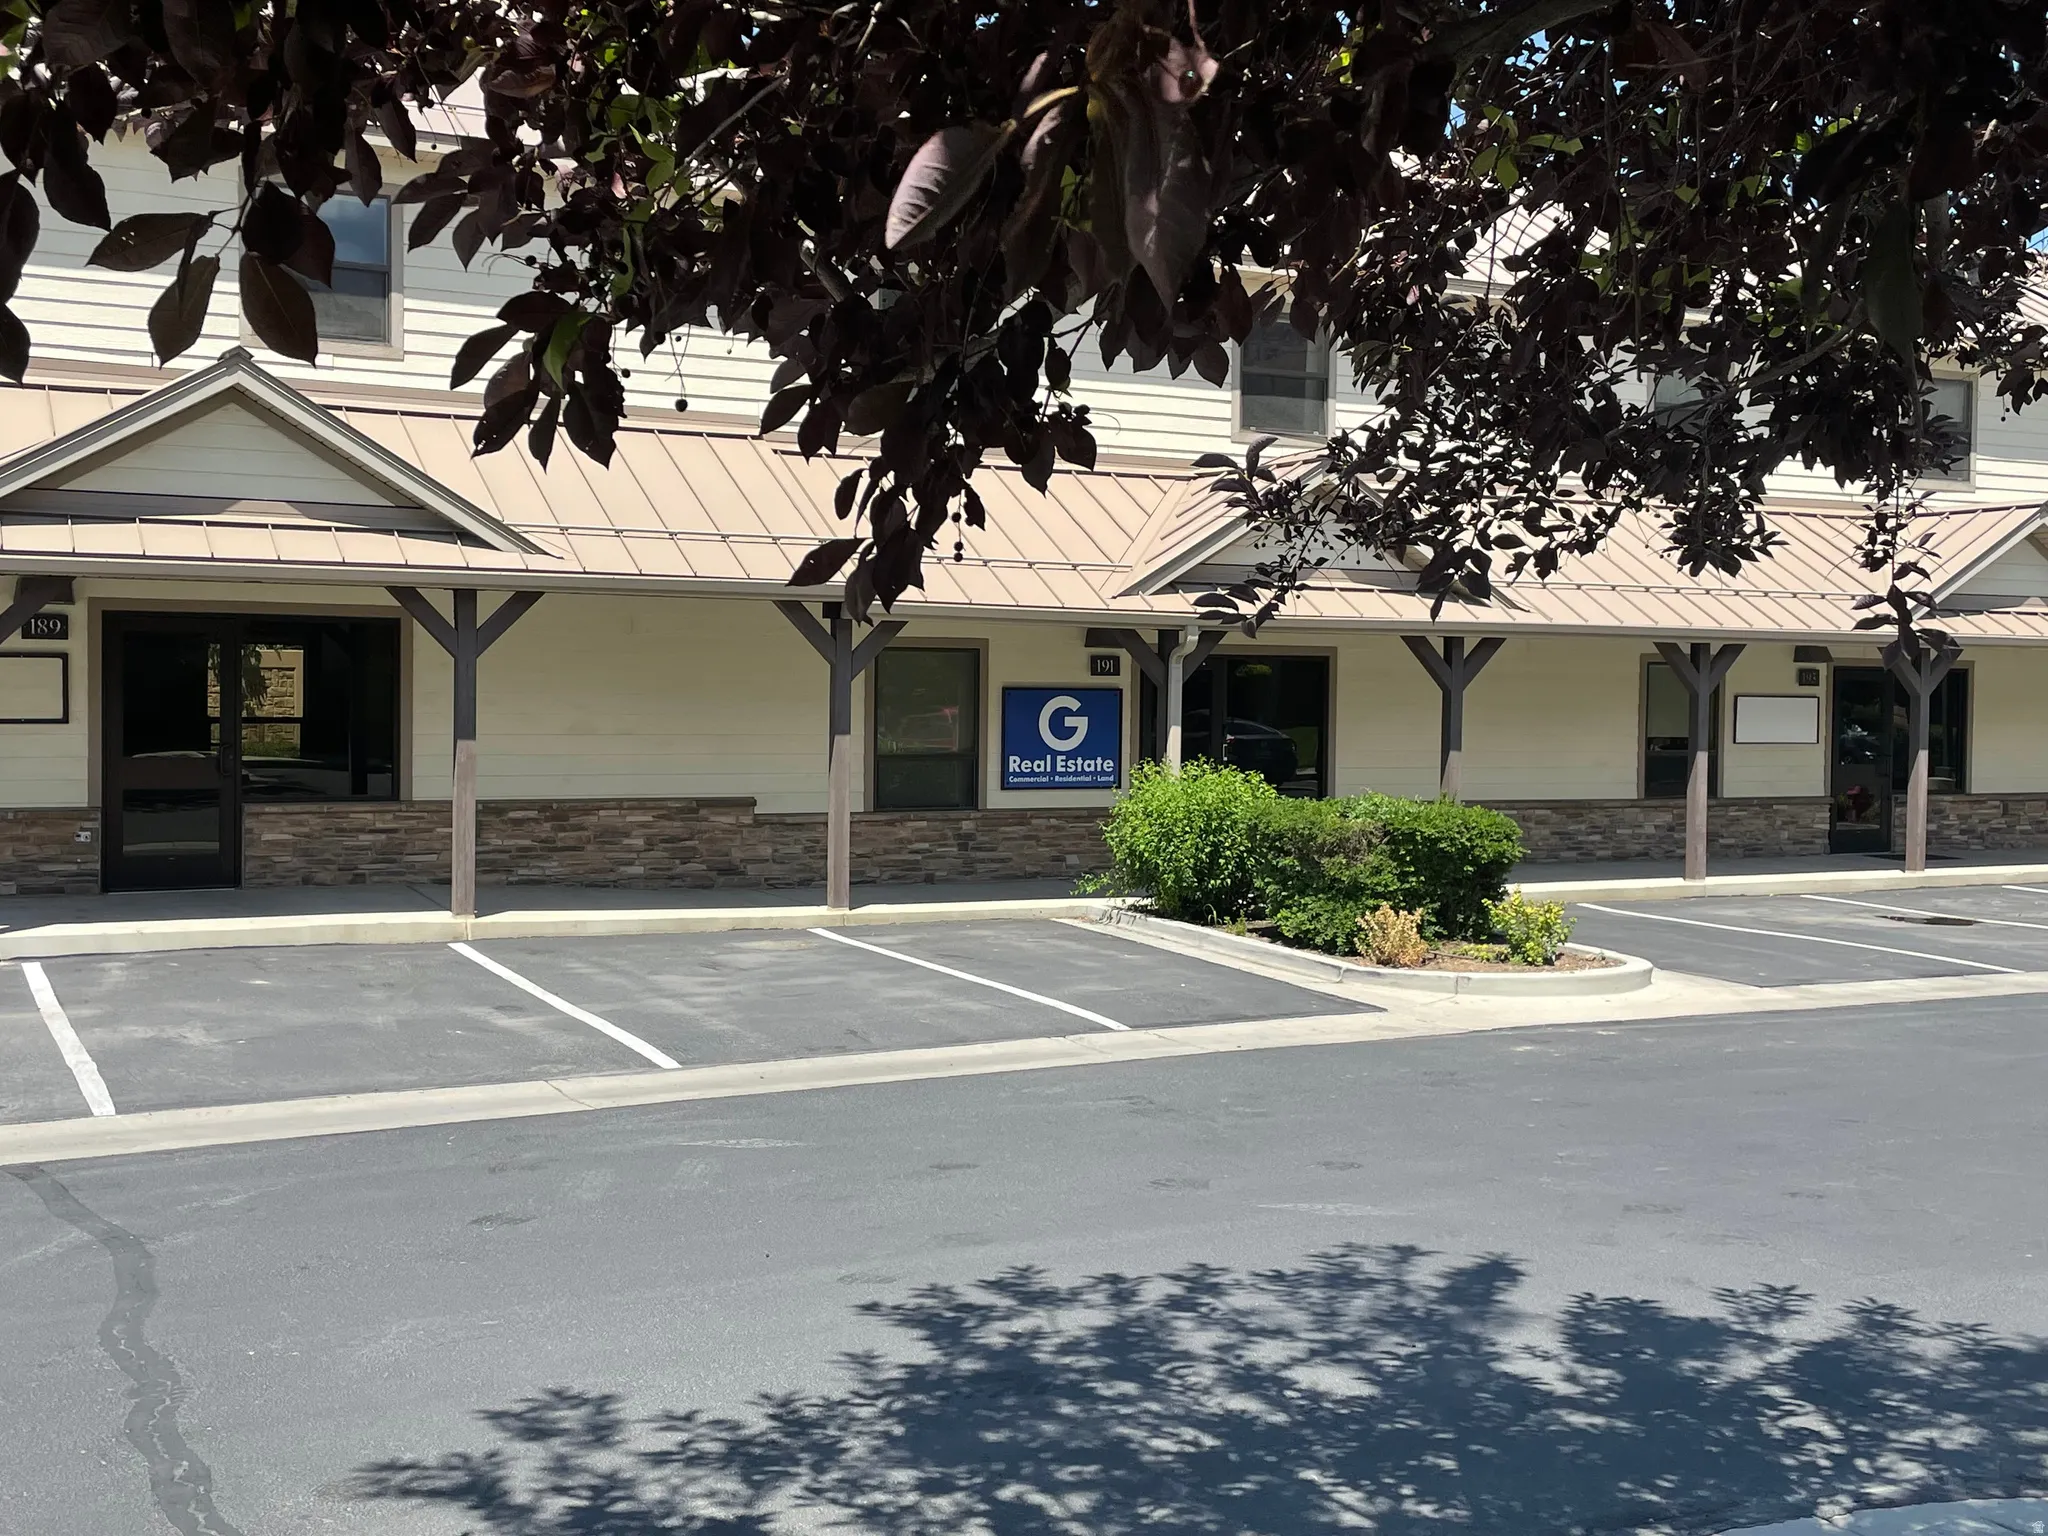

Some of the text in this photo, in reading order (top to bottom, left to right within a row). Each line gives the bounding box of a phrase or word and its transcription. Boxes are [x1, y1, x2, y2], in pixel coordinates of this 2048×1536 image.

[30, 618, 61, 635] 189
[1097, 659, 1114, 673] 191
[1038, 695, 1089, 752] G
[1009, 755, 1115, 773] Real Estate
[1009, 774, 1114, 783] Commercial Residential Land
